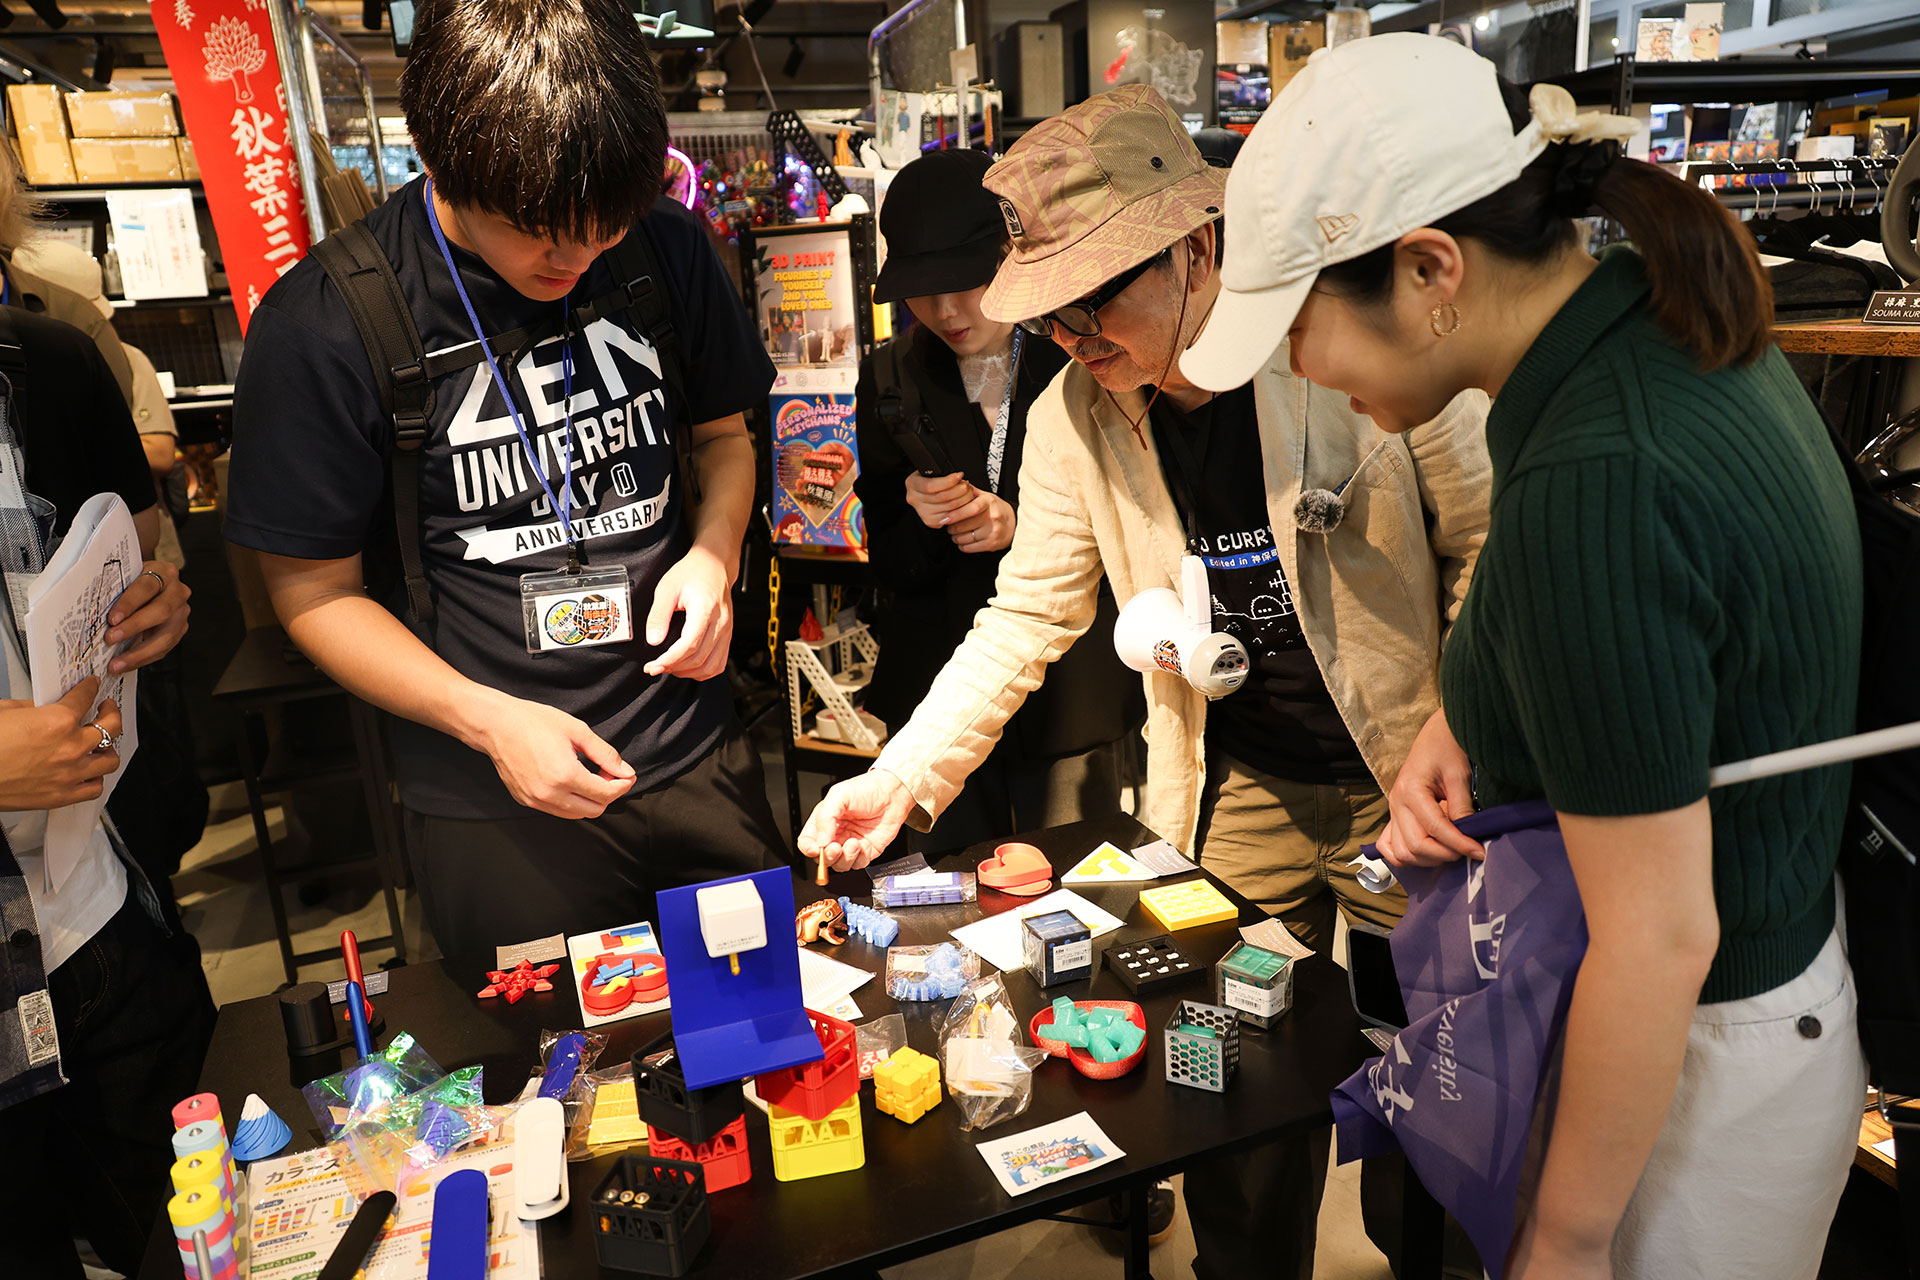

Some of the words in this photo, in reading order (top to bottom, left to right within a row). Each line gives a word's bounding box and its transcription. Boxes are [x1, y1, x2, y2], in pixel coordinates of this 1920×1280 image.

[771, 253, 789, 269] 3D
[793, 251, 835, 268] PRINT
[774, 270, 819, 281] FIGURINES
[821, 269, 833, 279] OF
[782, 280, 825, 291] YOURSELF
[783, 292, 801, 302] AND
[803, 290, 827, 300] YOUR
[781, 302, 807, 312] LOVED
[809, 300, 833, 310] ONES
[1872, 309, 1901, 317] SOUMA
[425, 317, 663, 447] ZEN
[776, 403, 854, 435] PERSONALIZED
[790, 415, 841, 437] KEYCHAINS
[530, 472, 600, 518] DAY
[515, 500, 661, 552] ANNVERSARY
[1209, 558, 1236, 568] Edited
[1239, 557, 1248, 565] in
